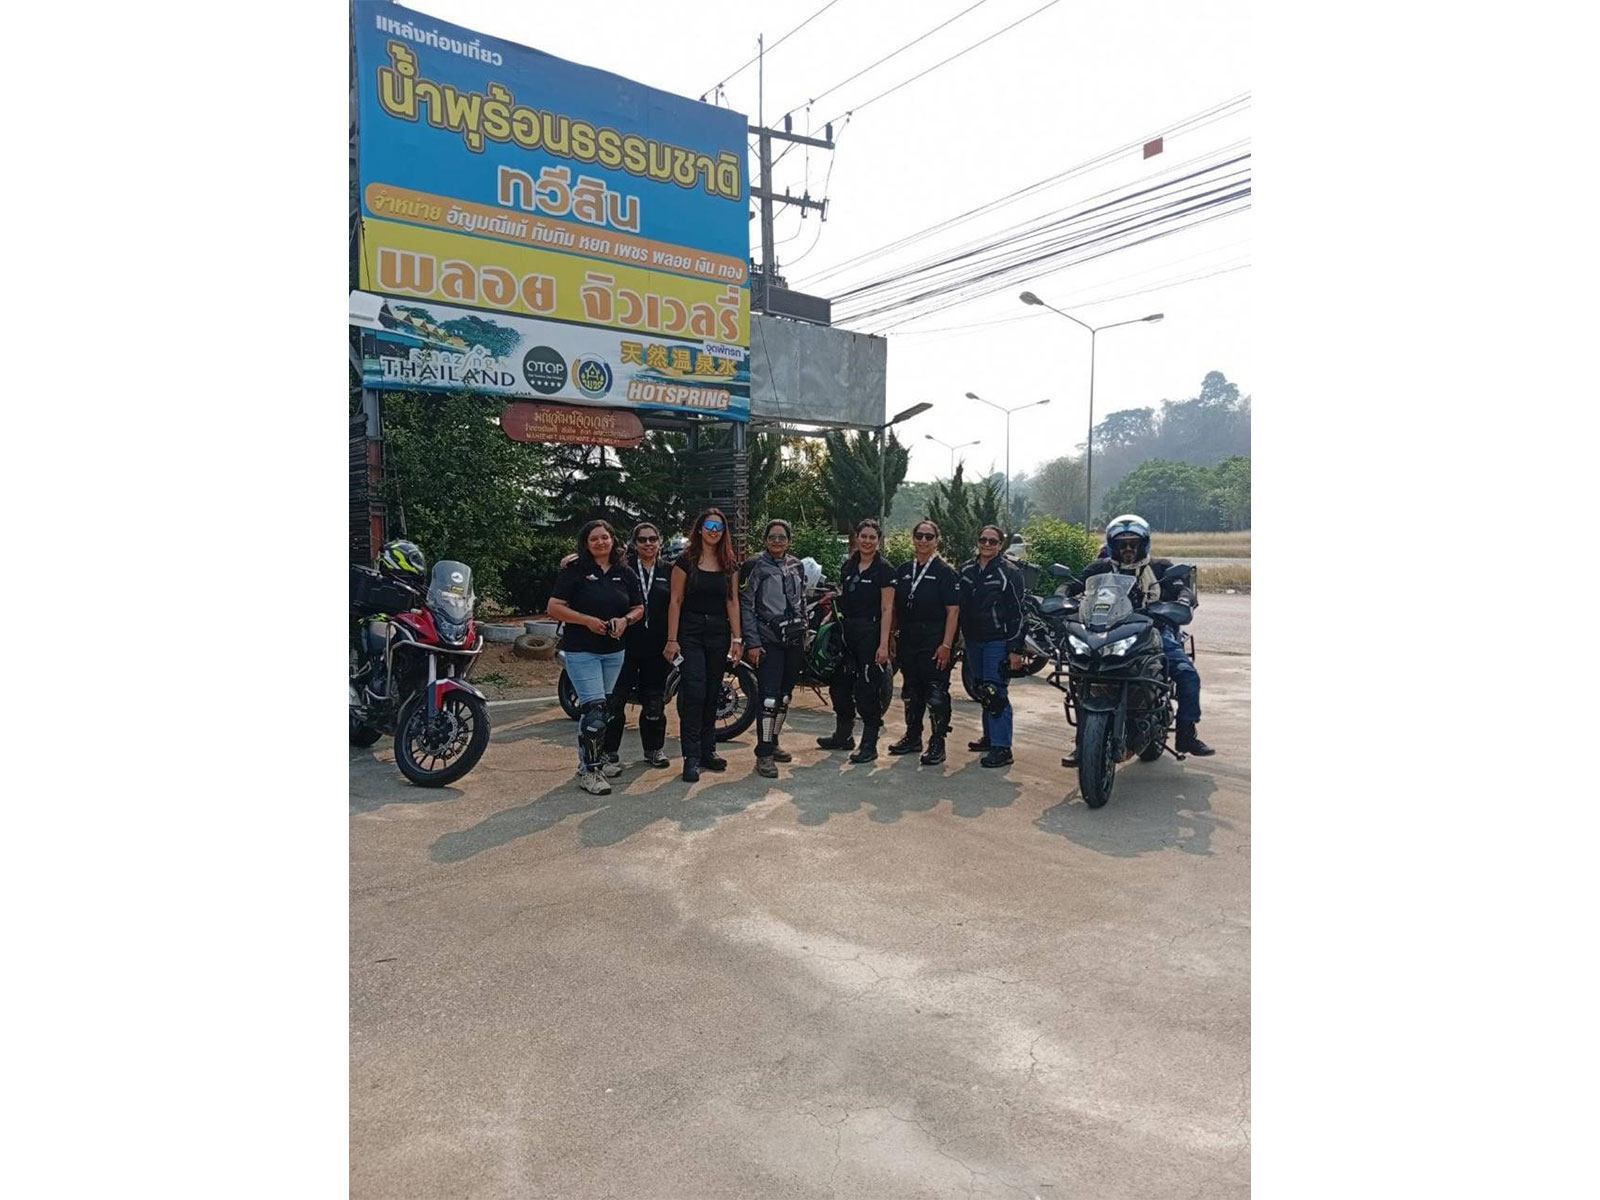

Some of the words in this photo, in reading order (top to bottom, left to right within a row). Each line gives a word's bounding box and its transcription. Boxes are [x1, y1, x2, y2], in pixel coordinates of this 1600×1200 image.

[376, 14, 503, 66] แหล่งท่องเที่ยว
[377, 40, 742, 200] น้ำพุร้อนธรรมชาติ
[498, 165, 640, 233] ทวีสิน
[374, 191, 442, 221] จำหน่าย
[614, 242, 649, 262] เพชร
[652, 250, 692, 270] พลอย
[718, 264, 743, 280] ทอง
[377, 247, 557, 314] พลอย
[581, 271, 740, 342] จิวเวลรี่
[382, 358, 516, 387] THAILAND
[526, 360, 564, 374] OTOP
[628, 381, 730, 410] HOTSPRING
